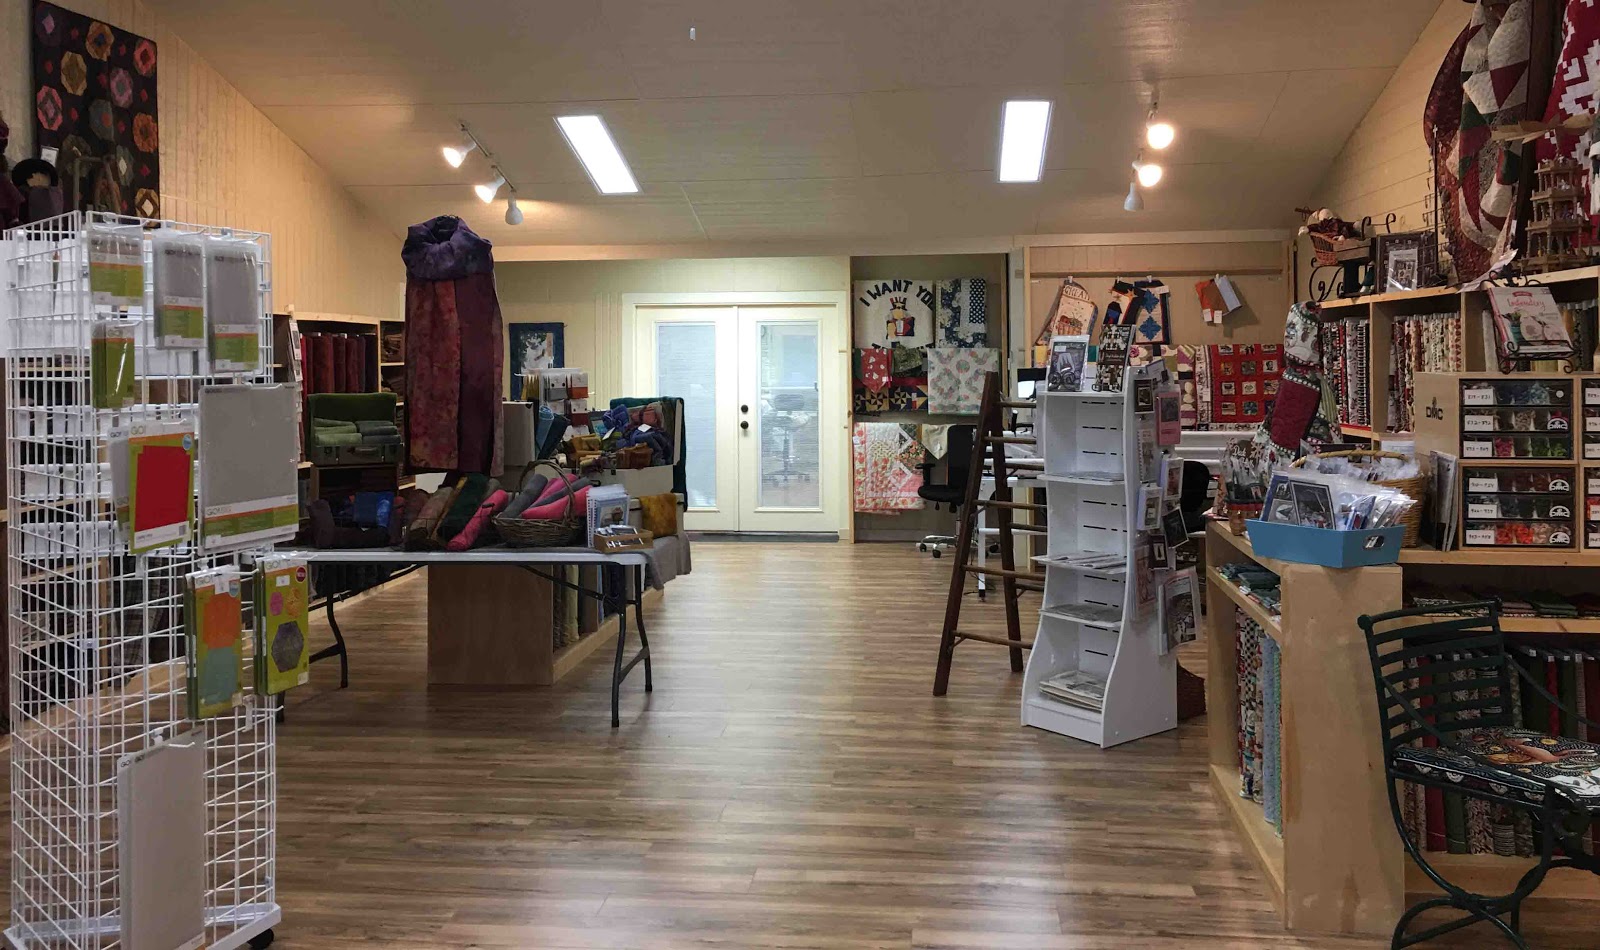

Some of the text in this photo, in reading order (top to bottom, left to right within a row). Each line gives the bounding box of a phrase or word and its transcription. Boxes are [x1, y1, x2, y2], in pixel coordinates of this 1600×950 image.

[859, 297, 870, 307] I
[867, 280, 913, 300] WANT
[1426, 406, 1443, 420] DMC
